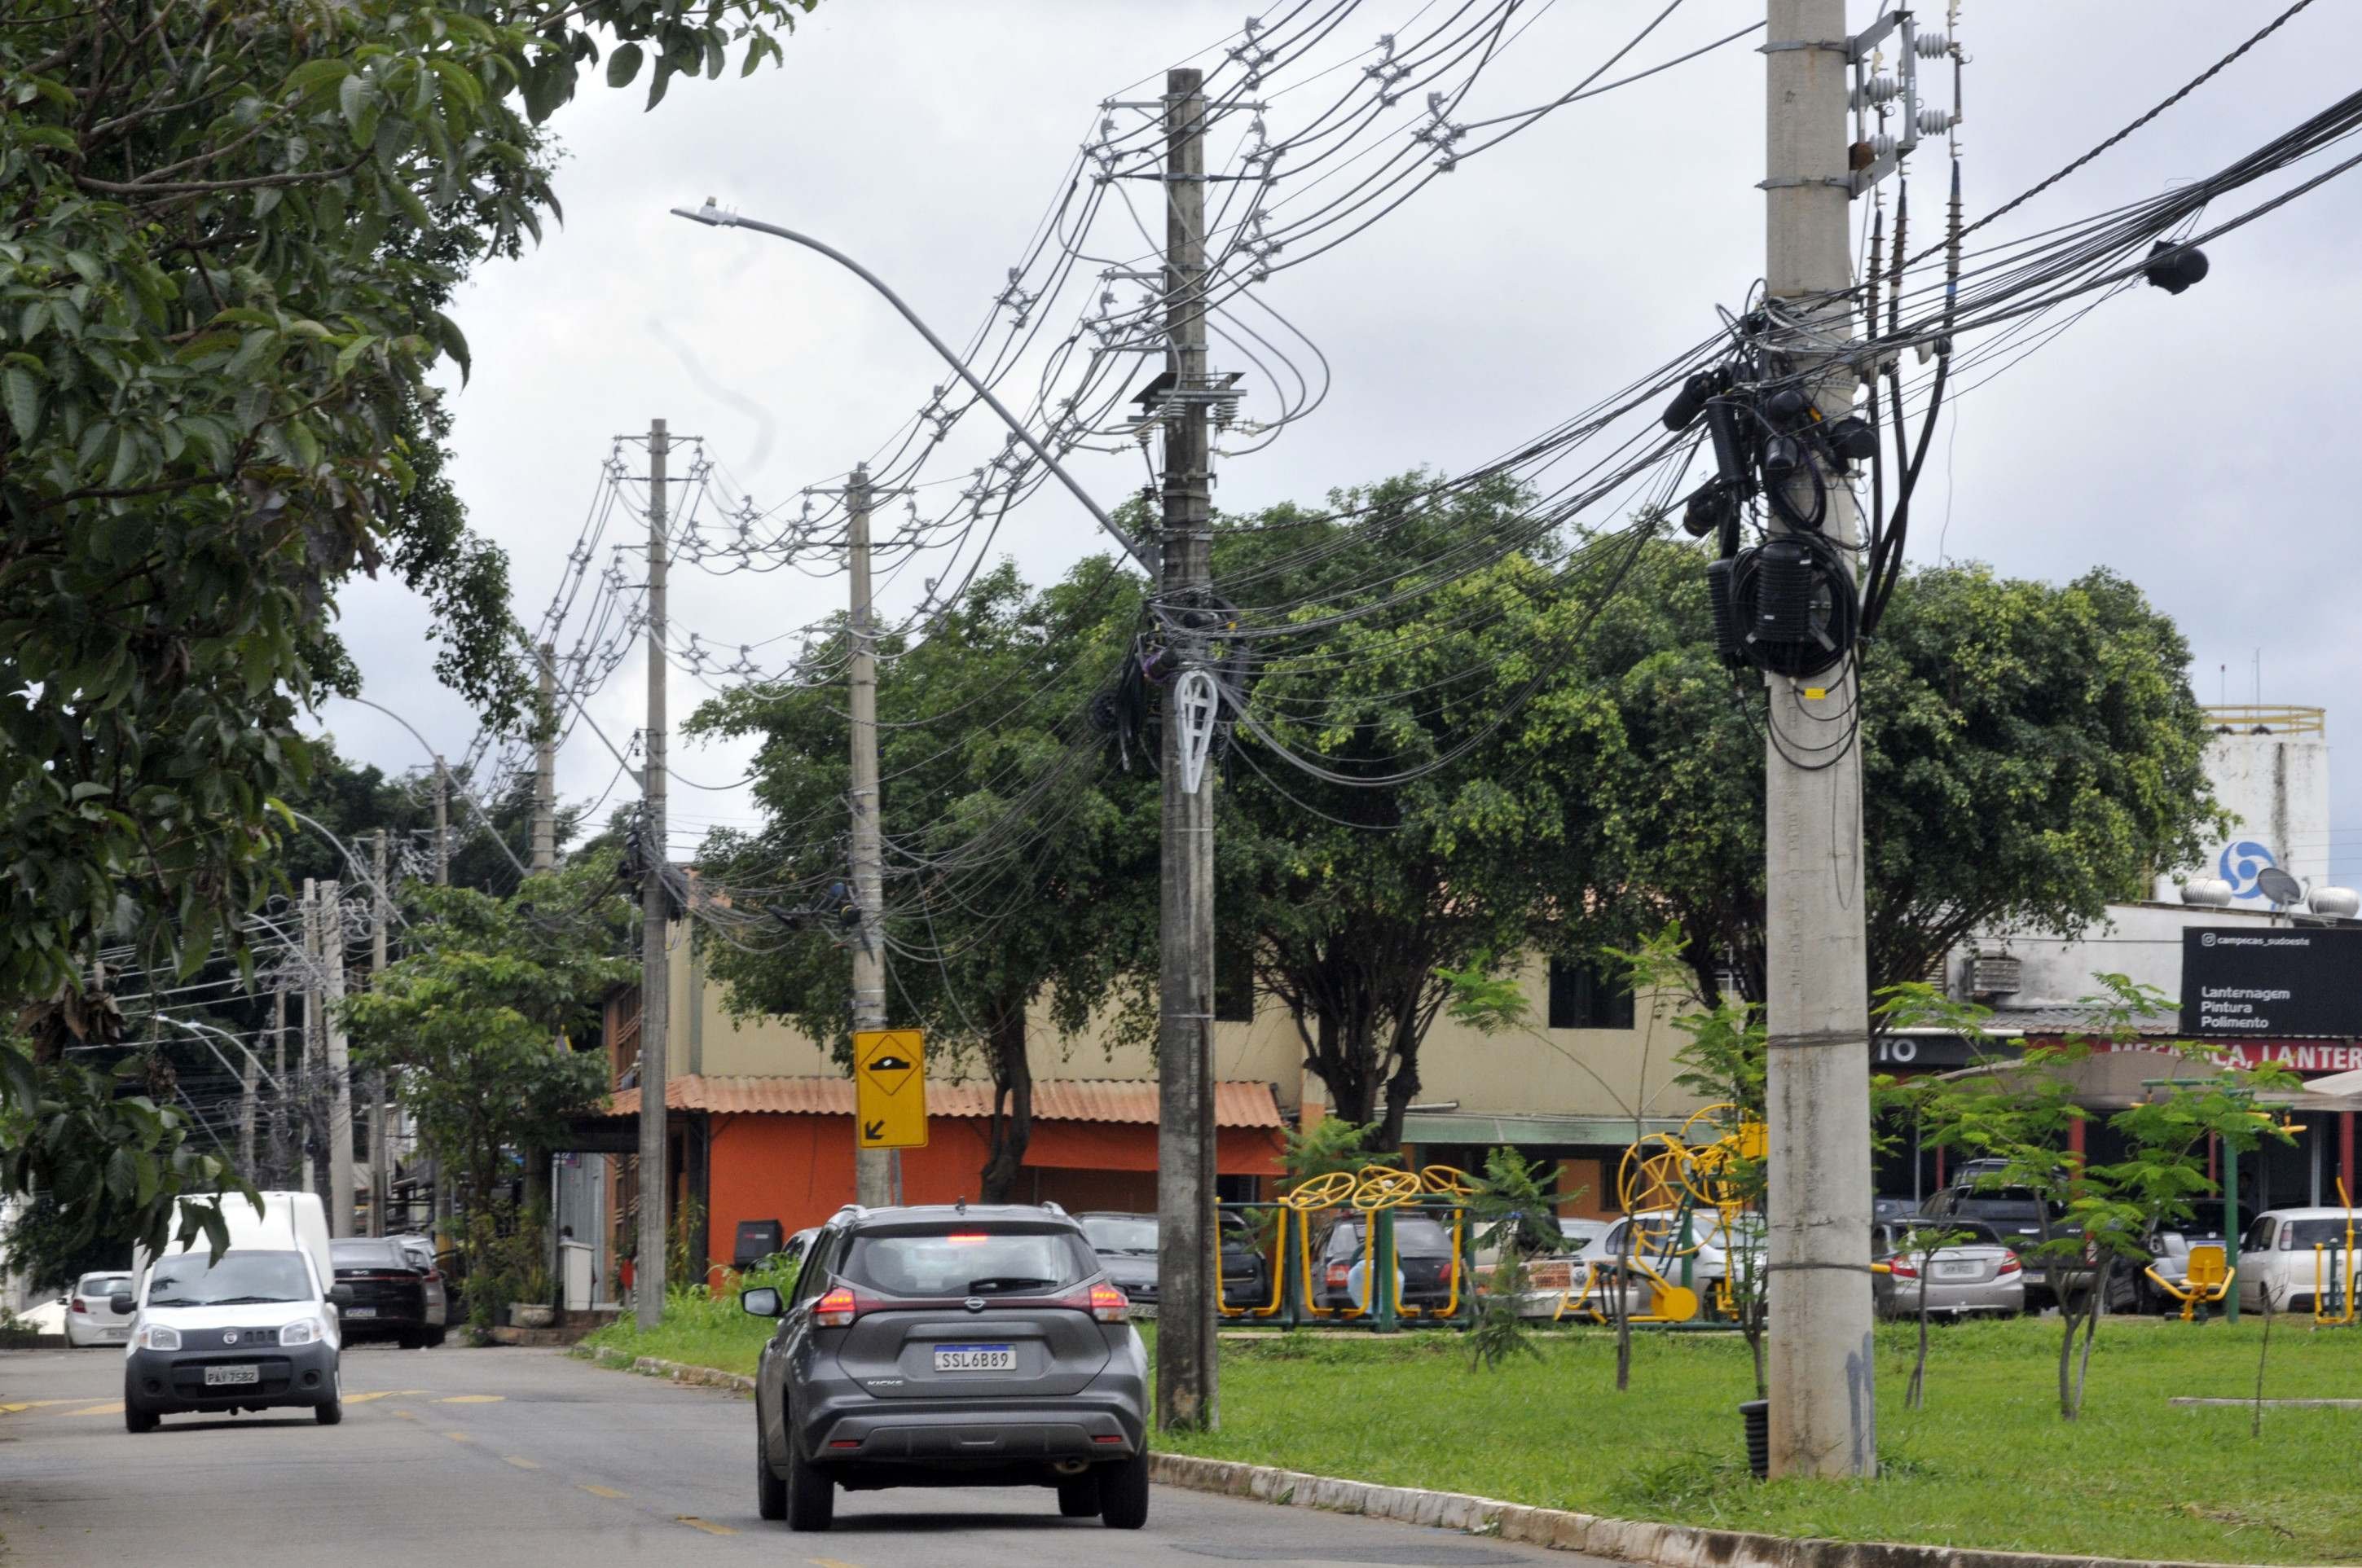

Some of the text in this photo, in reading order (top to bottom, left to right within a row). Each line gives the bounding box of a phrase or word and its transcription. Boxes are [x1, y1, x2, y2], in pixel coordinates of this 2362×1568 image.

[2201, 986, 2290, 1001] Lanternagem
[2201, 1001, 2253, 1013] Pintura
[2201, 1016, 2269, 1029] Polimento
[943, 1353, 1009, 1368] SSL6B89
